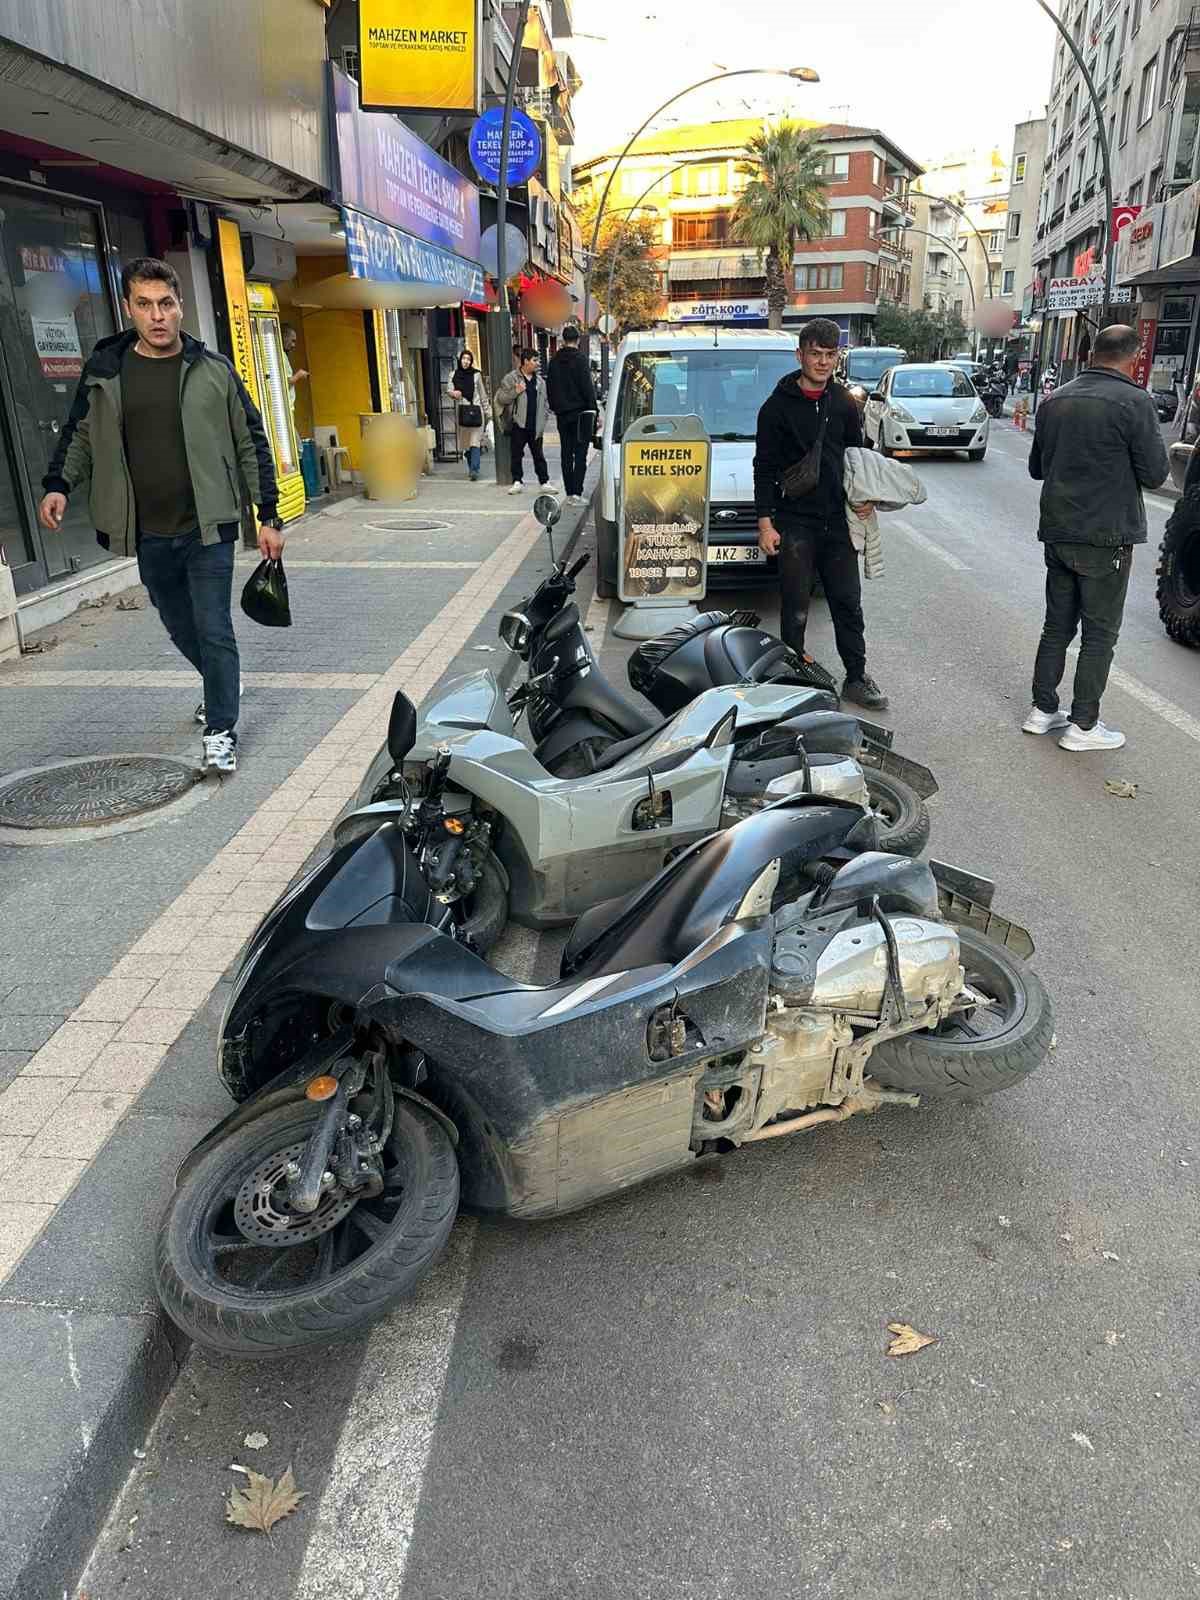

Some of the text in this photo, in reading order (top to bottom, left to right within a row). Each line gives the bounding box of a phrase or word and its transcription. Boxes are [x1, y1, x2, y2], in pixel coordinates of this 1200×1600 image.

[369, 28, 468, 44] MAHZEN MARKET
[1051, 277, 1097, 288] AKBAY
[692, 304, 749, 315] EĞİT-KOOP
[232, 303, 249, 383] MARKET
[640, 448, 692, 460] MAHZEN
[629, 465, 702, 476] TEKEL SHOP
[715, 547, 760, 561] AKZ 38
